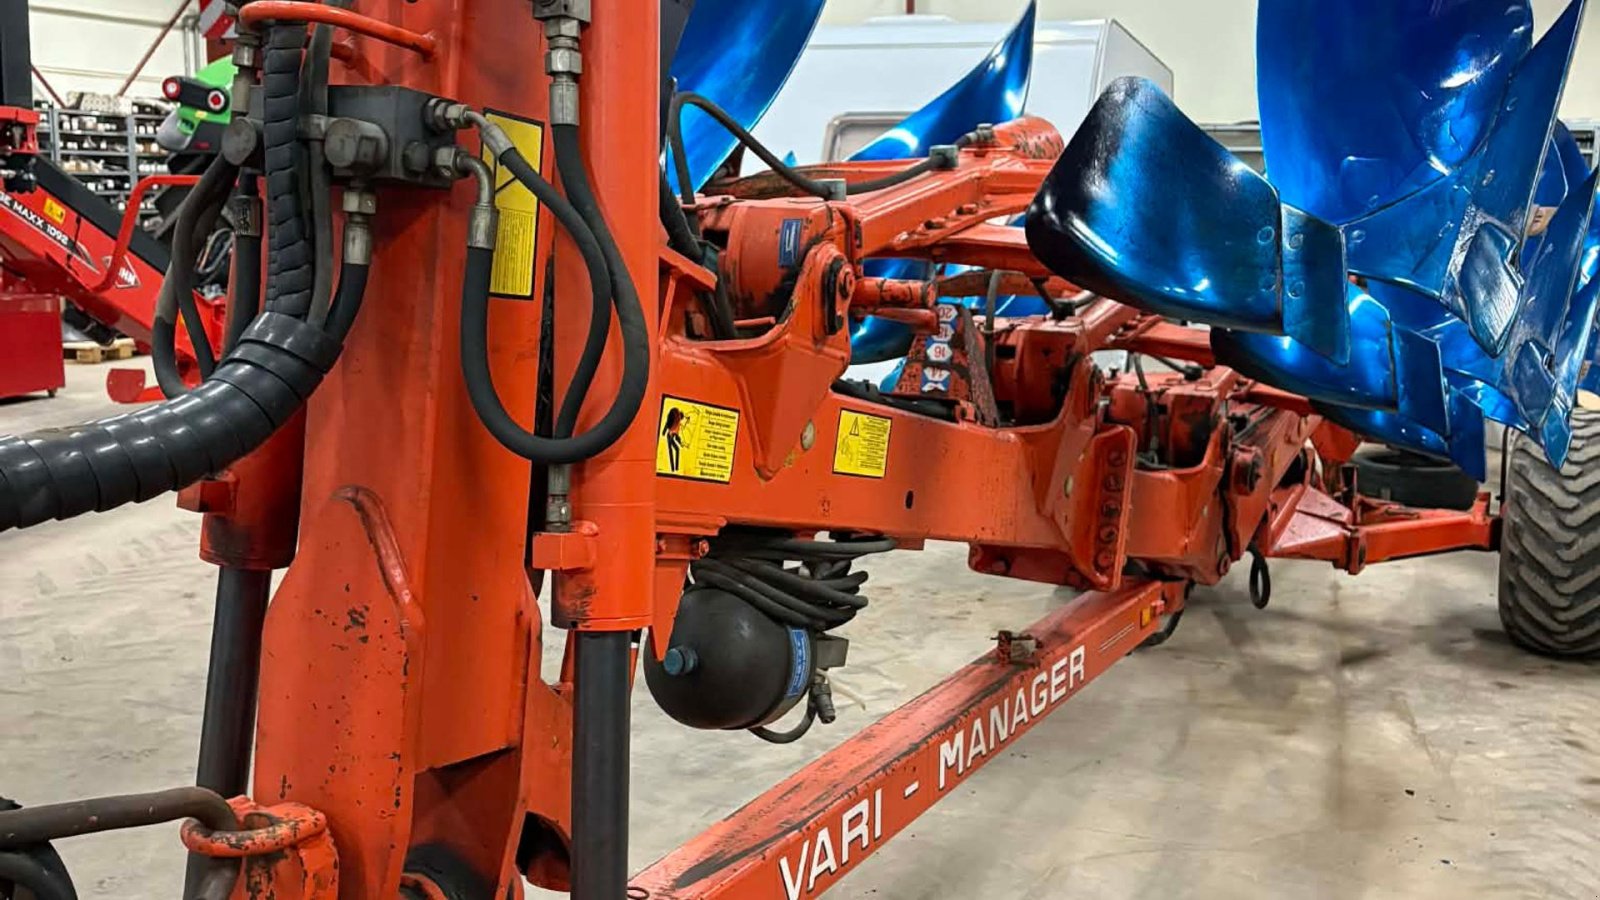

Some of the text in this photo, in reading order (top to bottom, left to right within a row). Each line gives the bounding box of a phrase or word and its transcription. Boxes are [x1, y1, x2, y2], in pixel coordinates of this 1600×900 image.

[13, 201, 44, 228] MAXX
[46, 223, 69, 246] 1092
[934, 346, 946, 358] 16
[779, 789, 882, 900] VARI
[939, 645, 1086, 790] MANAGER
